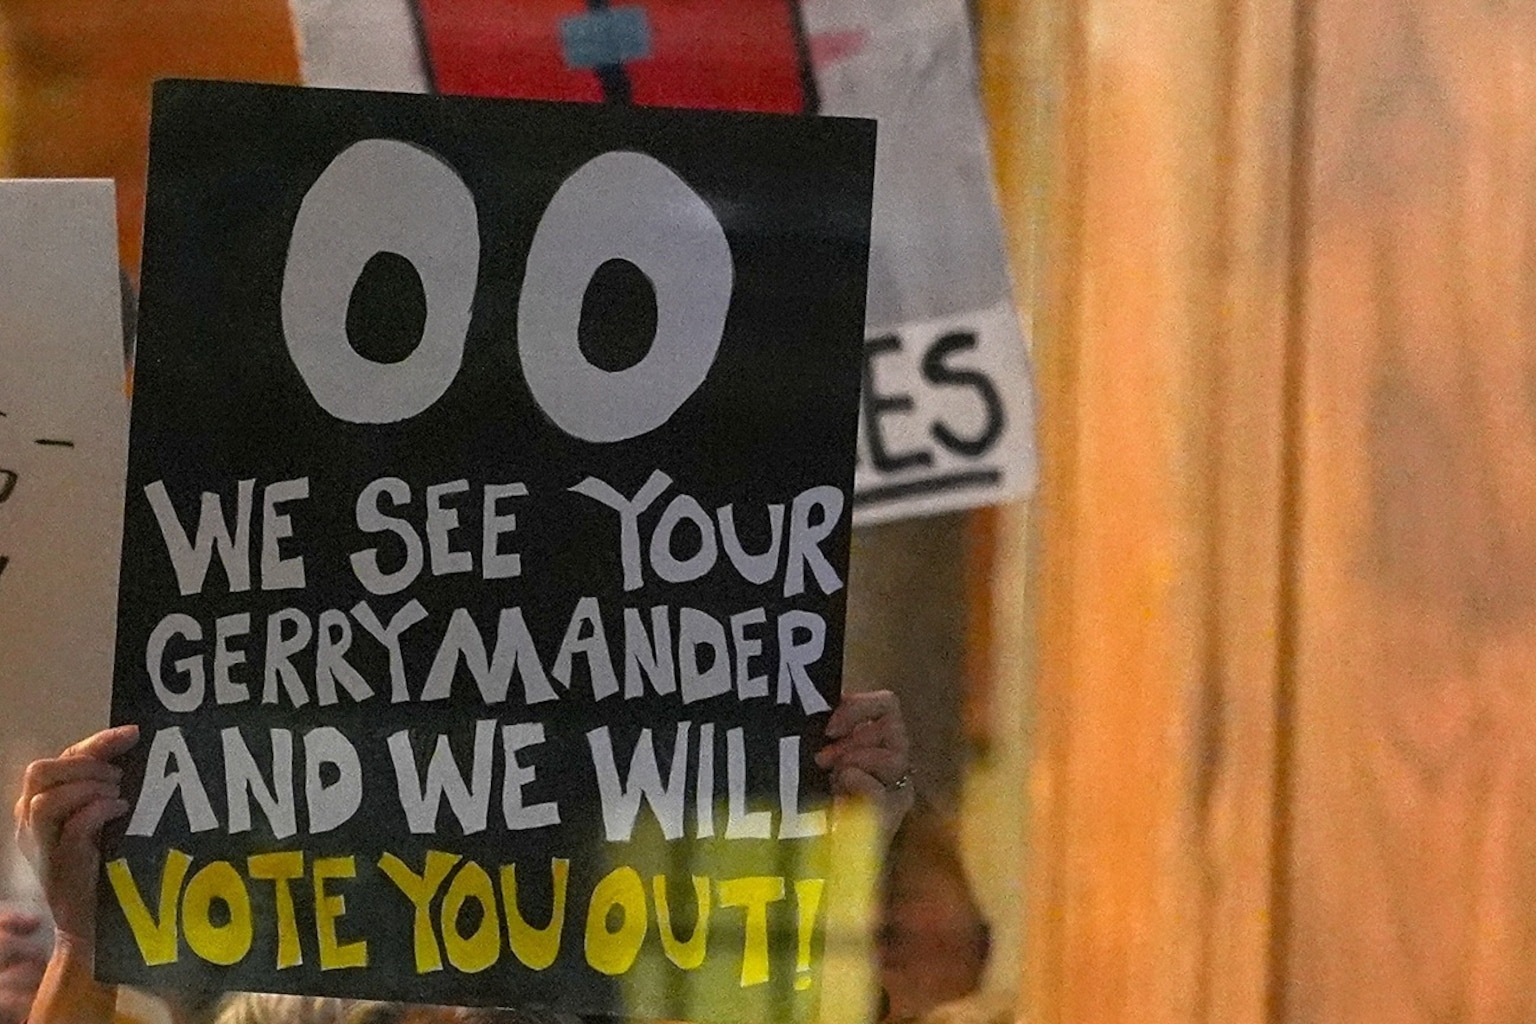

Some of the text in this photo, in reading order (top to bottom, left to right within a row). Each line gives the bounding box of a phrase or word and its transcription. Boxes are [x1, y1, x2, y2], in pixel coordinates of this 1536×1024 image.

[143, 467, 846, 598] WE SEE YOUR
[145, 594, 834, 717] GERRYMANDER
[124, 717, 828, 843] AND WE WILL
[104, 847, 826, 992] VOTE YOU OUT!
